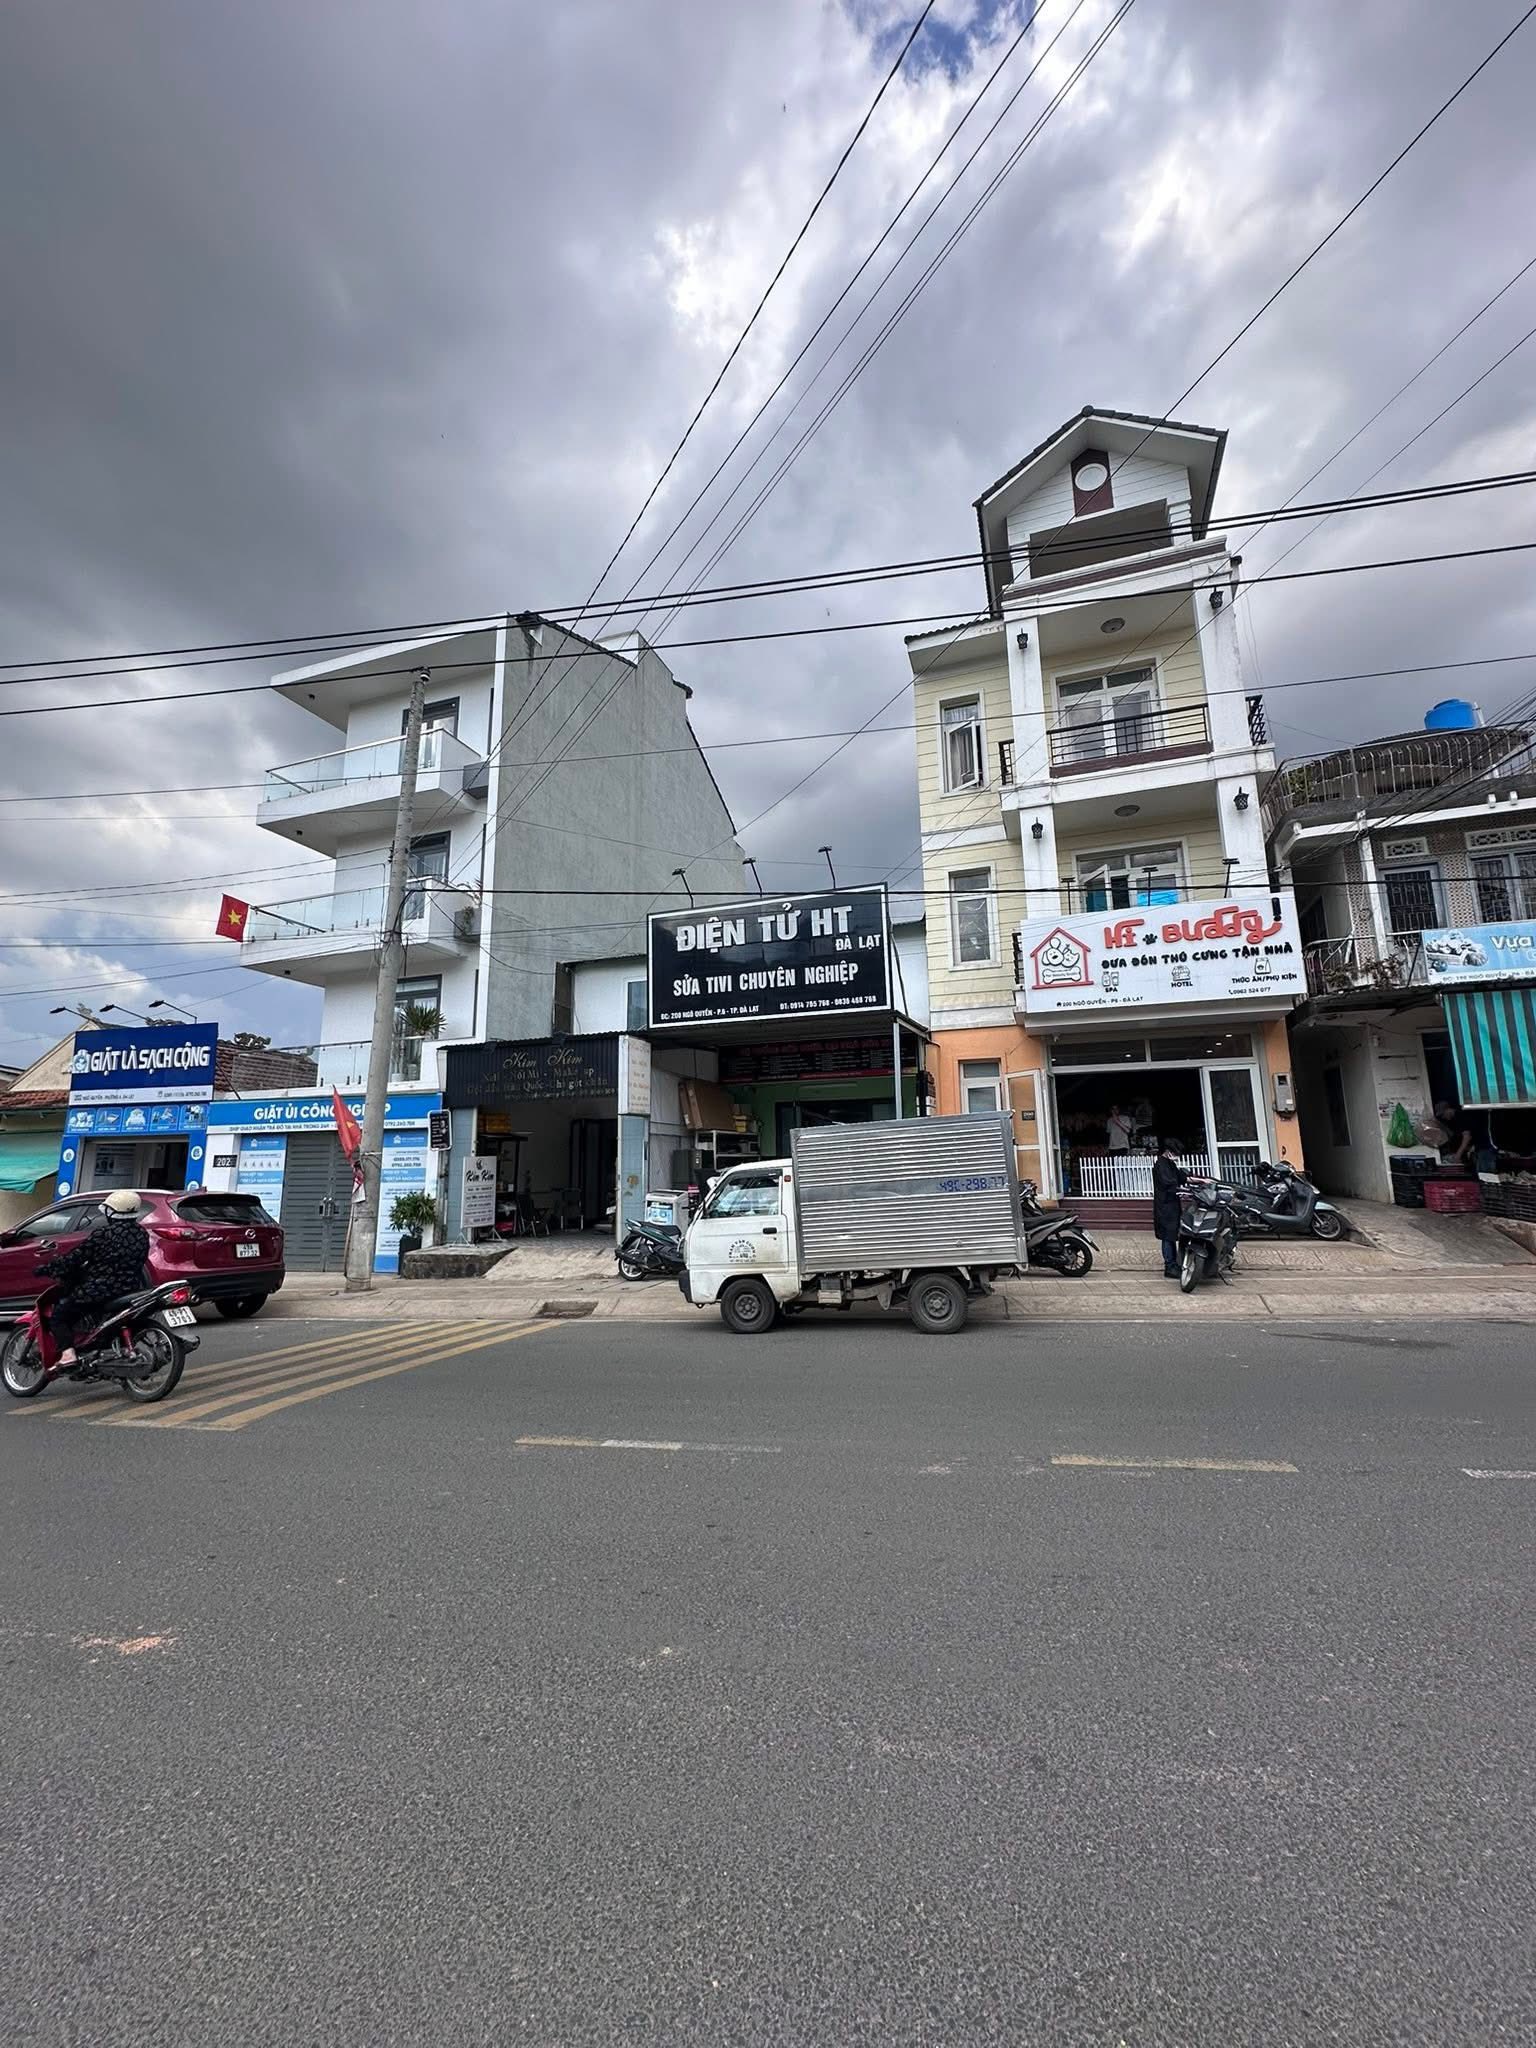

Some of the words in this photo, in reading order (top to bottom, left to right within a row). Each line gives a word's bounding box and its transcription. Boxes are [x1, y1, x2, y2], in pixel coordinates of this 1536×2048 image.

[676, 916, 746, 953] ĐIỆN
[758, 902, 801, 943] TỬ
[811, 905, 852, 937] HT
[1104, 918, 1144, 949] Hi
[835, 935, 852, 951] ĐÀ
[859, 934, 881, 950] LẠT
[1101, 957, 1127, 969] ĐƯA
[1131, 953, 1158, 967] ĐÓN
[1192, 948, 1228, 961] CƯNG
[1231, 945, 1260, 960] TẬN
[1264, 941, 1293, 955] NHÀ
[1490, 935, 1534, 953] Vựa
[673, 974, 700, 997] SỬA
[706, 975, 732, 994] TIVI
[739, 966, 796, 991] CHUYÊN
[804, 960, 859, 986] NGHIỆP
[91, 1046, 121, 1076] GIẶT
[121, 1045, 136, 1070] LÀ
[139, 1047, 172, 1075] SẠCH
[174, 1041, 211, 1071] CỘNG
[253, 1104, 283, 1123] GIẶT
[285, 1103, 298, 1119] ỦI
[217, 1157, 231, 1167] 202
